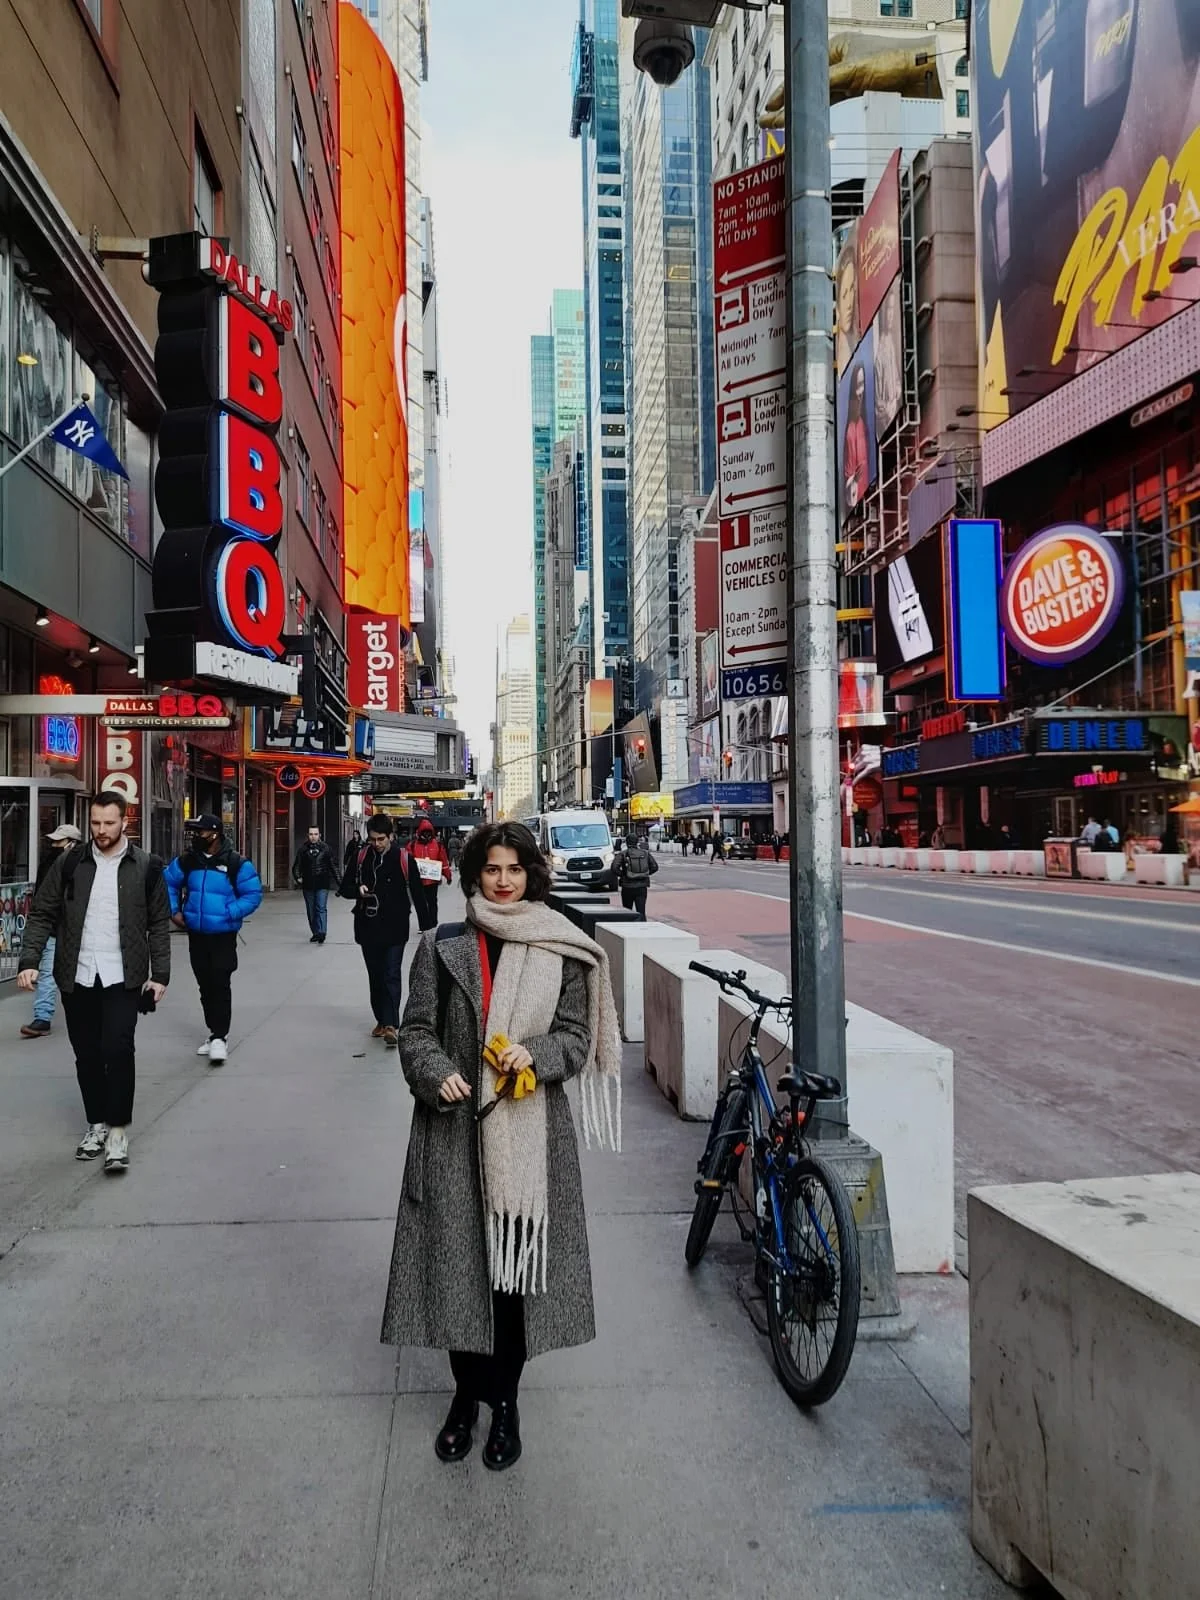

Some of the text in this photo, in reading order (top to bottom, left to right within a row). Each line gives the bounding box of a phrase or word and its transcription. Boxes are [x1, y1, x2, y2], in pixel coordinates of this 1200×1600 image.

[717, 182, 734, 201] NO
[718, 204, 737, 220] 7am
[746, 191, 770, 210] 10am
[718, 218, 738, 236] 2pm
[718, 226, 757, 249] All Days
[208, 236, 292, 331] DALLAS
[752, 276, 779, 296] Truck
[752, 289, 785, 309] Loadin
[752, 305, 774, 321] Only
[720, 332, 757, 355] Midnight
[721, 352, 756, 372] All Days
[754, 391, 780, 409] Truck
[754, 404, 786, 422] Loadin
[754, 420, 775, 435] Only
[722, 450, 755, 467] Sunday
[221, 293, 286, 658] BBQ
[723, 469, 746, 483] 10am
[754, 461, 775, 477] 2pm
[730, 512, 771, 547] 1 hour
[753, 520, 787, 535] metered
[753, 532, 784, 547] parking
[725, 551, 788, 576] COMMERCIA
[725, 570, 775, 592] VEHICLES
[1018, 549, 1101, 610] DAVE &
[725, 612, 750, 624] 10am
[758, 607, 778, 619] 2pm
[1022, 575, 1106, 635] BUSTER'S
[725, 623, 756, 638] Except
[362, 621, 395, 711] target
[109, 695, 224, 717] DALLAS BBQ
[136, 718, 181, 726] CHICKEN
[47, 716, 78, 756] BBQ
[1048, 719, 1144, 750] DINER
[101, 727, 139, 804] BQ
[309, 780, 317, 791] L
